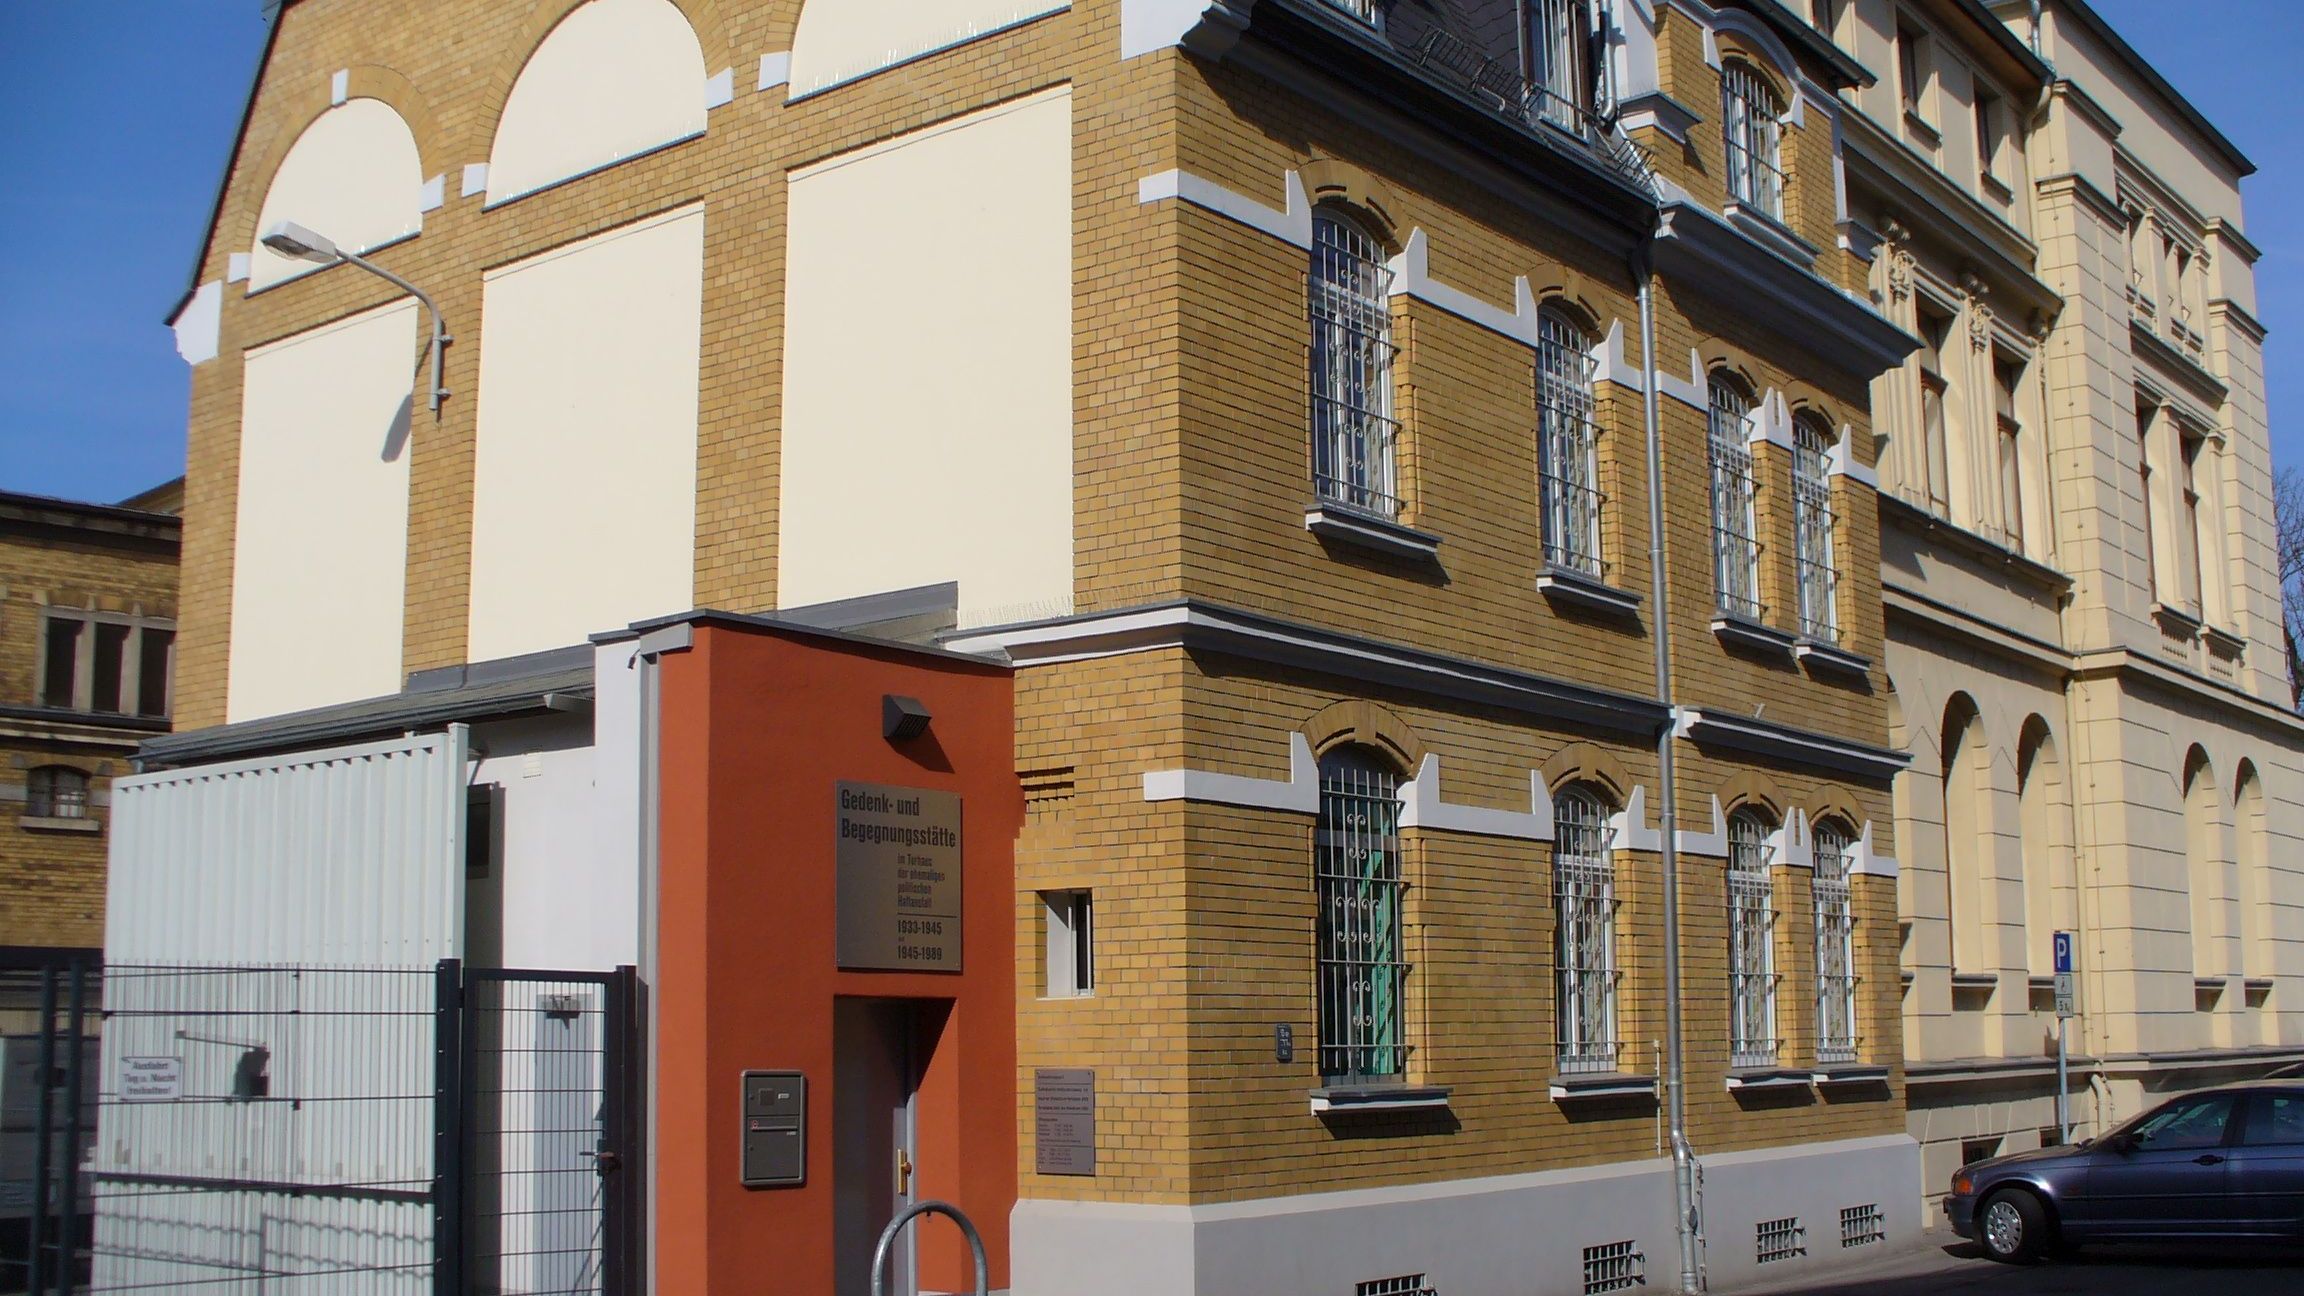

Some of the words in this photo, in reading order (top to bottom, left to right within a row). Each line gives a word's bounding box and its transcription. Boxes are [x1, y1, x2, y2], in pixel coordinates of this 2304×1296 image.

[841, 789, 894, 813] Gedenk-
[897, 797, 920, 816] und
[841, 818, 956, 847] Begegnungsstätte
[897, 920, 942, 936] 1933-1945
[897, 946, 942, 960] 1945-1989
[2056, 938, 2067, 968] P
